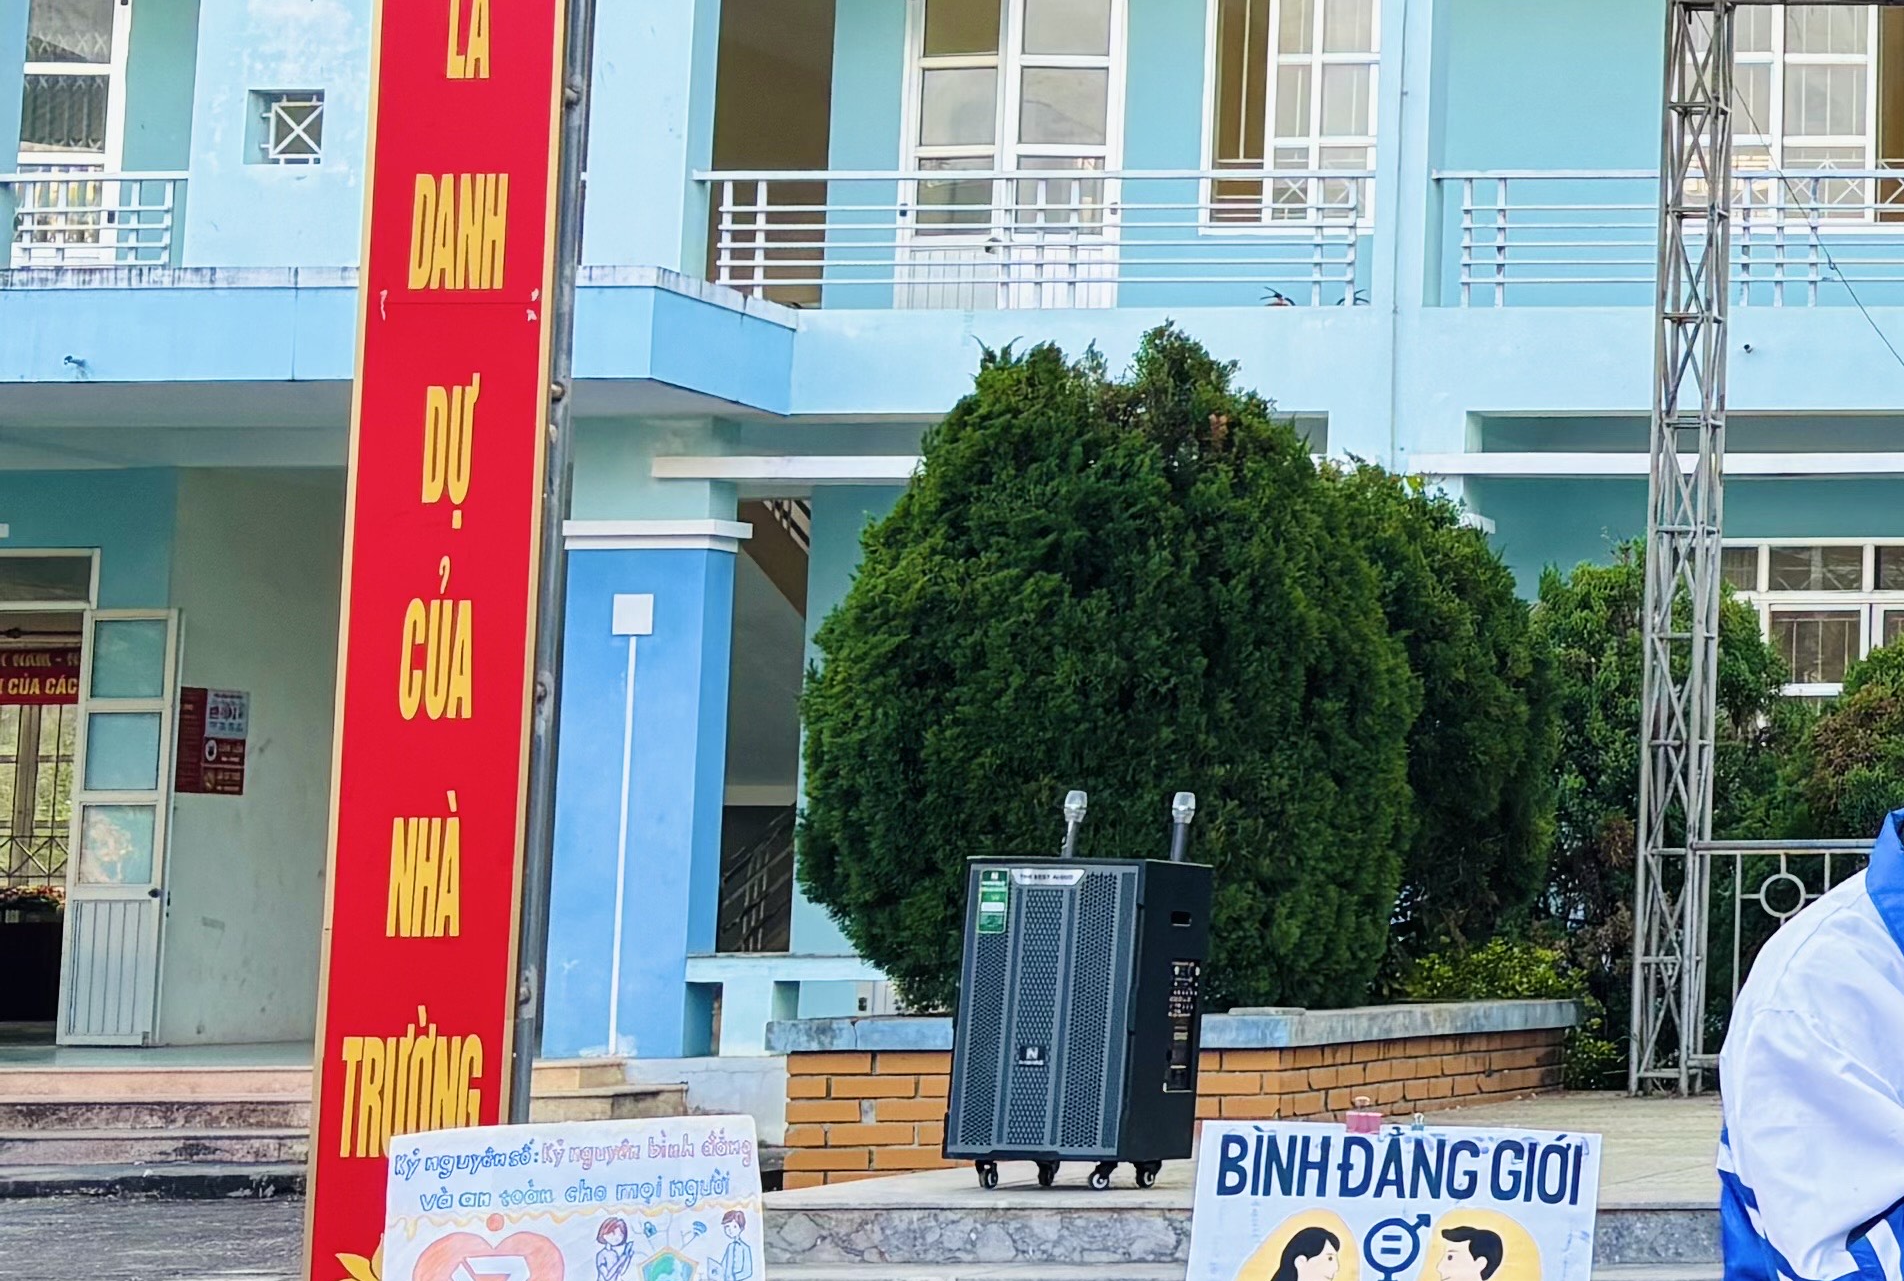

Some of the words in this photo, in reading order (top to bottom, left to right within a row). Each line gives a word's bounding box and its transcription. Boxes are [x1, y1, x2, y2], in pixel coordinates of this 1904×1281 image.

[408, 173, 509, 291] DANH
[421, 372, 481, 530] DỰ
[8, 673, 40, 695] CỦA
[45, 674, 78, 695] CÁC
[399, 556, 472, 720] CỦA
[386, 790, 459, 937] NHÀ
[339, 1005, 483, 1158] TRƯỜNG
[394, 1148, 420, 1181] Kỷ
[425, 1147, 507, 1179] nguyên
[542, 1138, 565, 1167] Kỷ
[569, 1138, 641, 1170] nguyên
[648, 1129, 695, 1158] bình
[419, 1186, 454, 1212] và
[458, 1191, 492, 1208] an
[499, 1179, 554, 1207] toàn
[564, 1179, 608, 1203] cho
[615, 1175, 662, 1204] mọi
[669, 1168, 730, 1207] người
[1216, 1125, 1331, 1198] BÌNH
[1337, 1125, 1480, 1201] ĐẲNG
[1490, 1133, 1583, 1206] GIỚI
